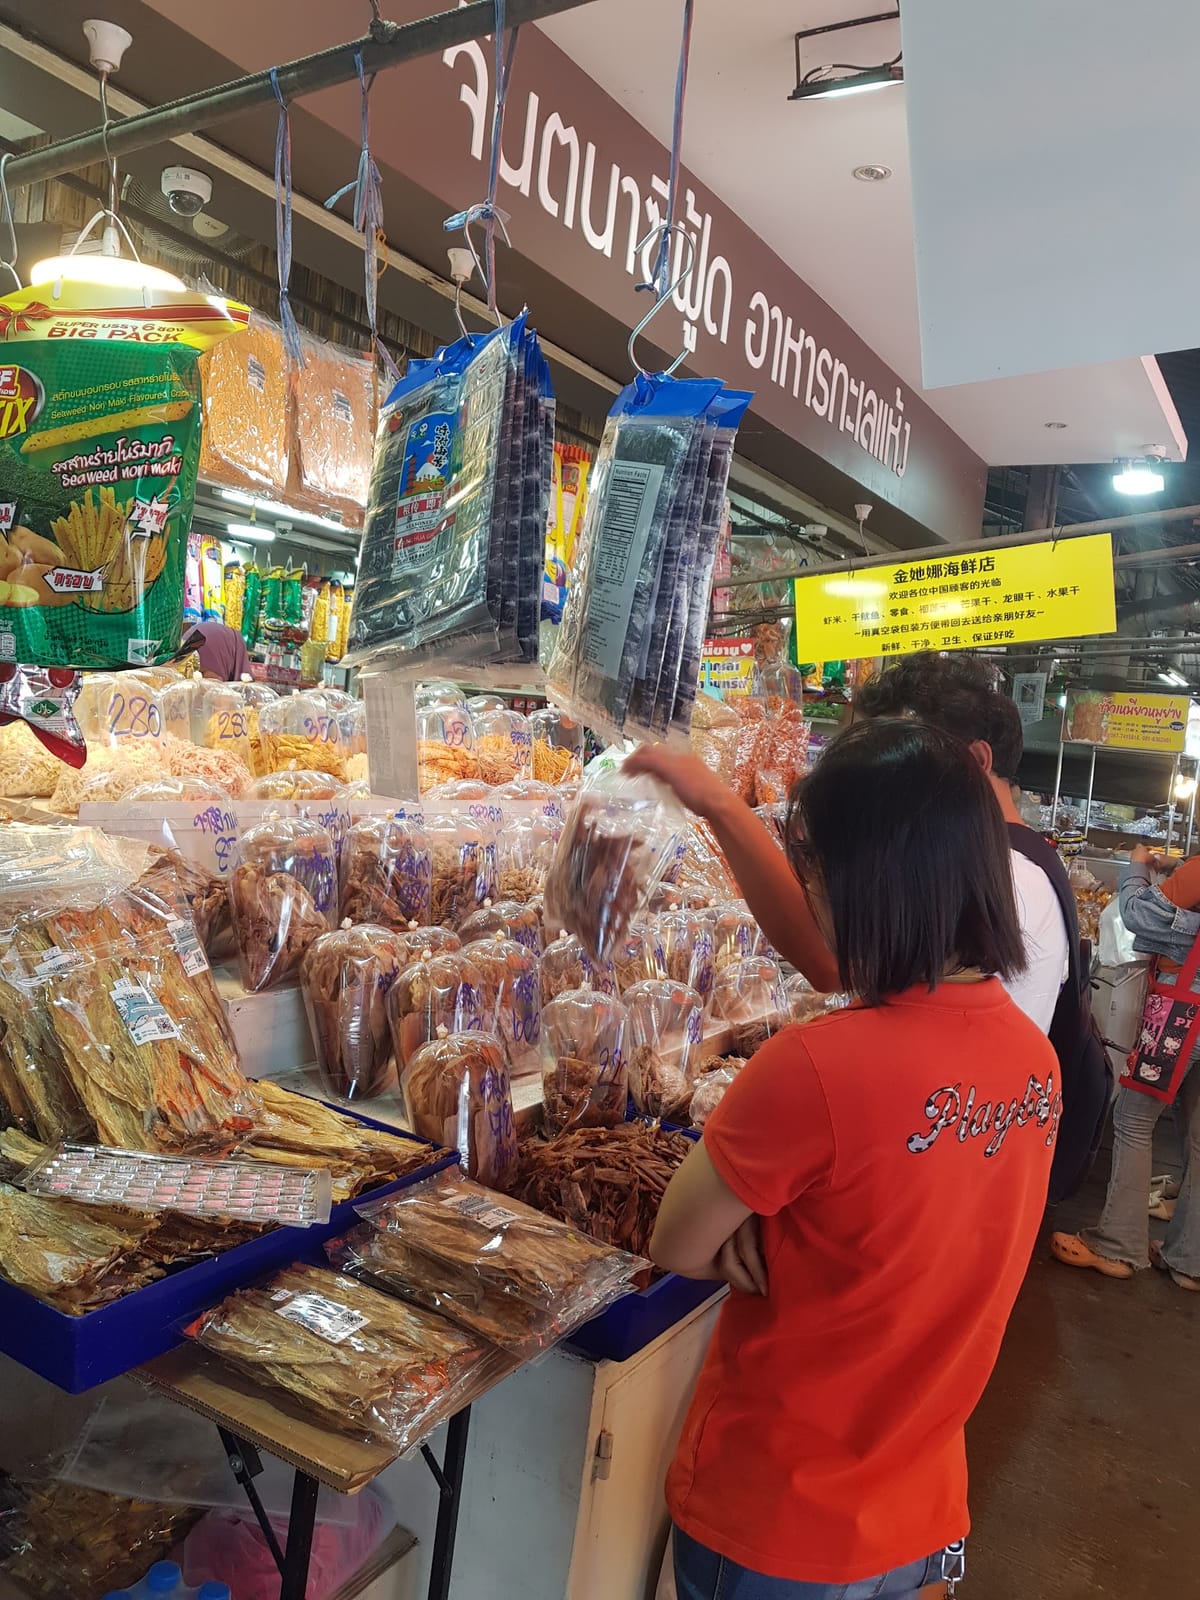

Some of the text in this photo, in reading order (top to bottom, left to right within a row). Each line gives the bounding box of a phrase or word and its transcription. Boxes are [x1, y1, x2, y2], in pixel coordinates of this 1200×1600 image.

[47, 327, 183, 343] BIG PACK
[745, 291, 911, 478] อาหารทะเลแห้ง
[151, 457, 182, 475] maki
[893, 557, 996, 584] 金她娜海鲜店
[888, 578, 1002, 600] 欢迎各位中国顾客的光临
[881, 630, 1015, 651] 新鲜、干净、卫生、保证好吃
[108, 692, 161, 737] 280
